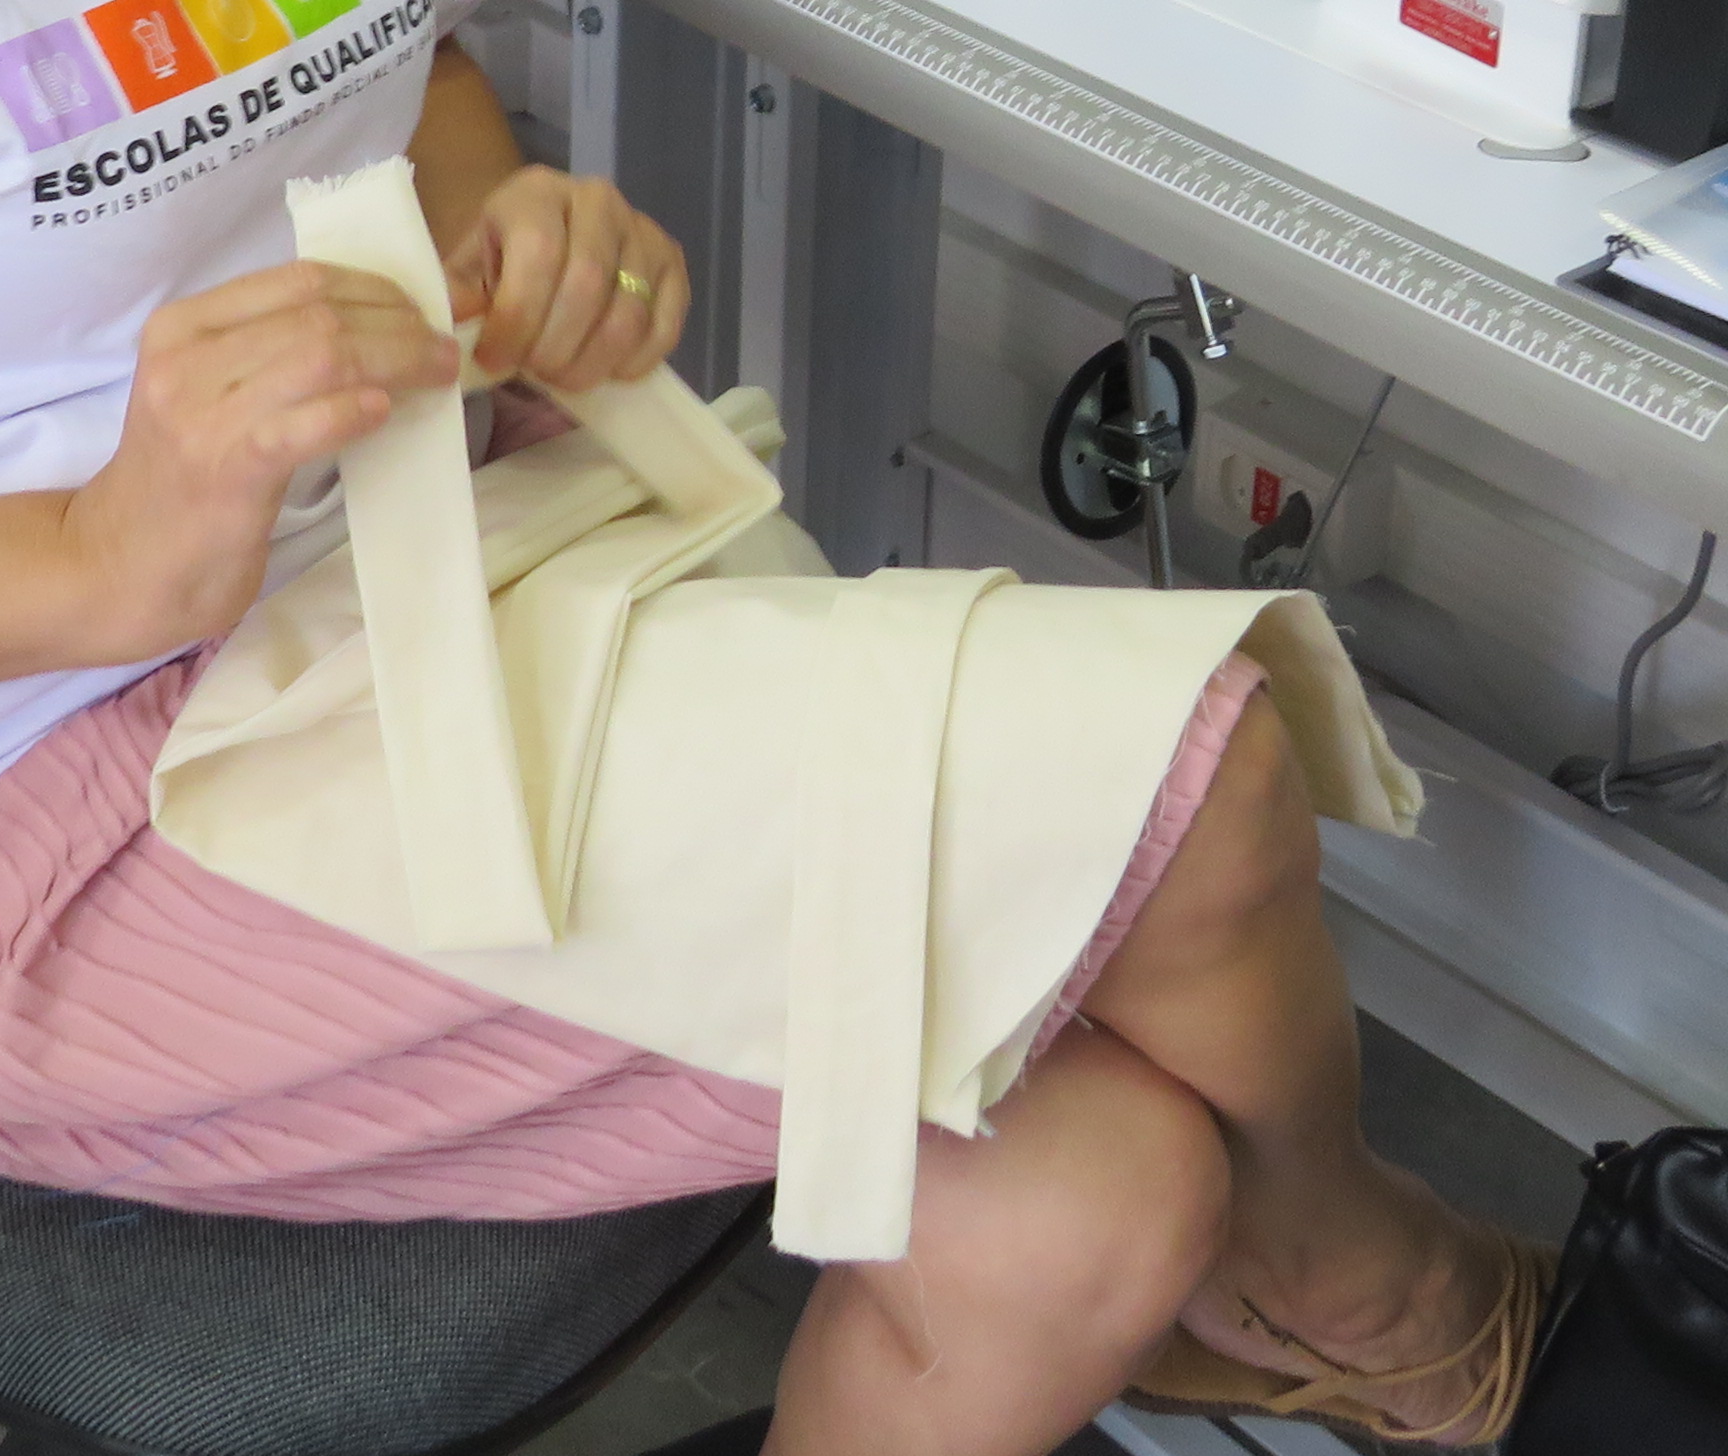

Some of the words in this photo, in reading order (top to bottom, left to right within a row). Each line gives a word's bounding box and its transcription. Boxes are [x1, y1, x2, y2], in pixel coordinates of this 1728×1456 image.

[31, 155, 220, 231] PROFISSIONAL
[228, 139, 256, 163] DO
[33, 104, 231, 204] ESCOLAS
[238, 77, 284, 125] DE
